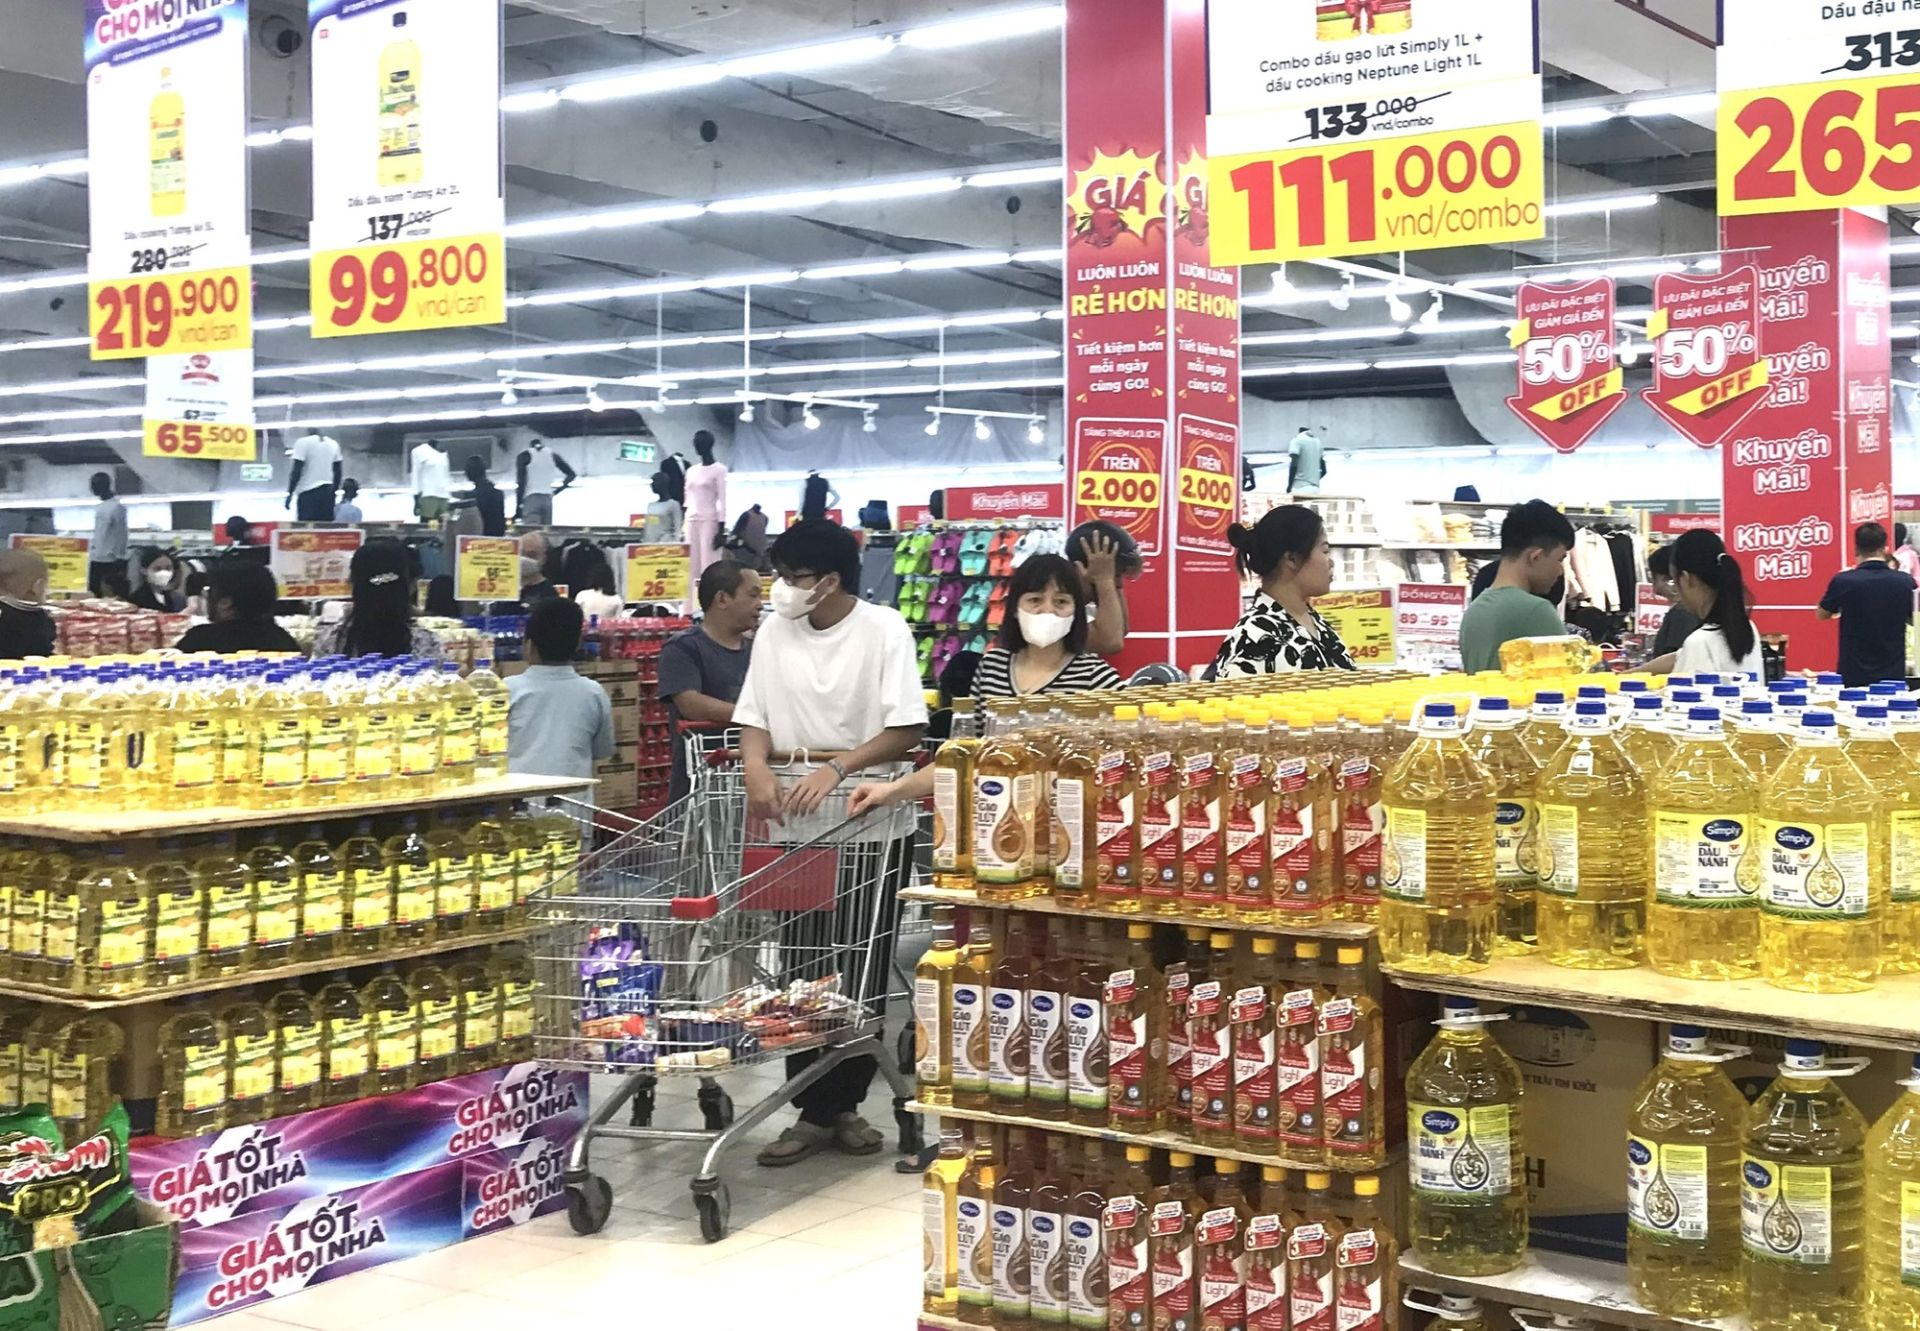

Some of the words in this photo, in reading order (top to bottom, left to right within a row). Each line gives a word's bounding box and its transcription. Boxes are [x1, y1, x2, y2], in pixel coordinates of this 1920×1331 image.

[98, 9, 140, 44] CHO
[1259, 56, 1310, 73] Combo
[1399, 36, 1450, 55] Simply
[1454, 33, 1470, 47] 1L
[1296, 71, 1353, 89] cooking
[1357, 63, 1419, 81] Neptune
[1424, 56, 1462, 73] Light
[1467, 53, 1482, 66] 1L
[1085, 171, 1151, 216] GIÁ
[1230, 135, 1521, 251] 111.000
[1386, 196, 1540, 238] vnd/combo
[1077, 264, 1116, 281] LUÔN
[1119, 260, 1159, 278] LUÔN
[1760, 257, 1827, 291] uyến
[96, 275, 239, 351] 219.900
[416, 290, 487, 318] vnd/can
[1071, 284, 1105, 317] RẺ
[1107, 286, 1166, 313] HƠN
[1523, 330, 1610, 386] 50%
[1659, 321, 1755, 377] 50%
[1769, 343, 1828, 378] uyến
[1559, 377, 1608, 414] OFF
[1699, 370, 1752, 408] OFF
[1771, 380, 1807, 406] ãi!
[1101, 453, 1140, 471] TRÊN
[1735, 430, 1828, 464] Khuyến
[1080, 477, 1157, 502] 2.000
[1758, 468, 1808, 493] Mãi!
[1737, 517, 1829, 552] Khuyến
[1759, 554, 1809, 579] Mãi!
[1706, 822, 1742, 837] Simply
[1777, 829, 1813, 846] Simply
[458, 1083, 507, 1127] GIÁ
[506, 1067, 559, 1110] TỐT
[449, 1122, 494, 1154] CHO
[496, 1106, 533, 1137] MỌI
[536, 1084, 579, 1121] NHÀ
[1424, 1114, 1457, 1130] Simply
[153, 1151, 213, 1202] GIÁ
[214, 1128, 282, 1182] TỐT
[201, 1176, 248, 1213] MỌI
[253, 1153, 306, 1194] NHÀ
[482, 1160, 521, 1202] GIÁ
[520, 1142, 564, 1187] TỐT
[473, 1198, 510, 1227] CHO
[512, 1182, 544, 1211] MỌI
[221, 1223, 286, 1276] GIÁ
[285, 1198, 359, 1251] TỐT
[207, 1268, 268, 1307] CHO
[272, 1246, 324, 1284] MỌI
[328, 1219, 386, 1262] NHÀ
